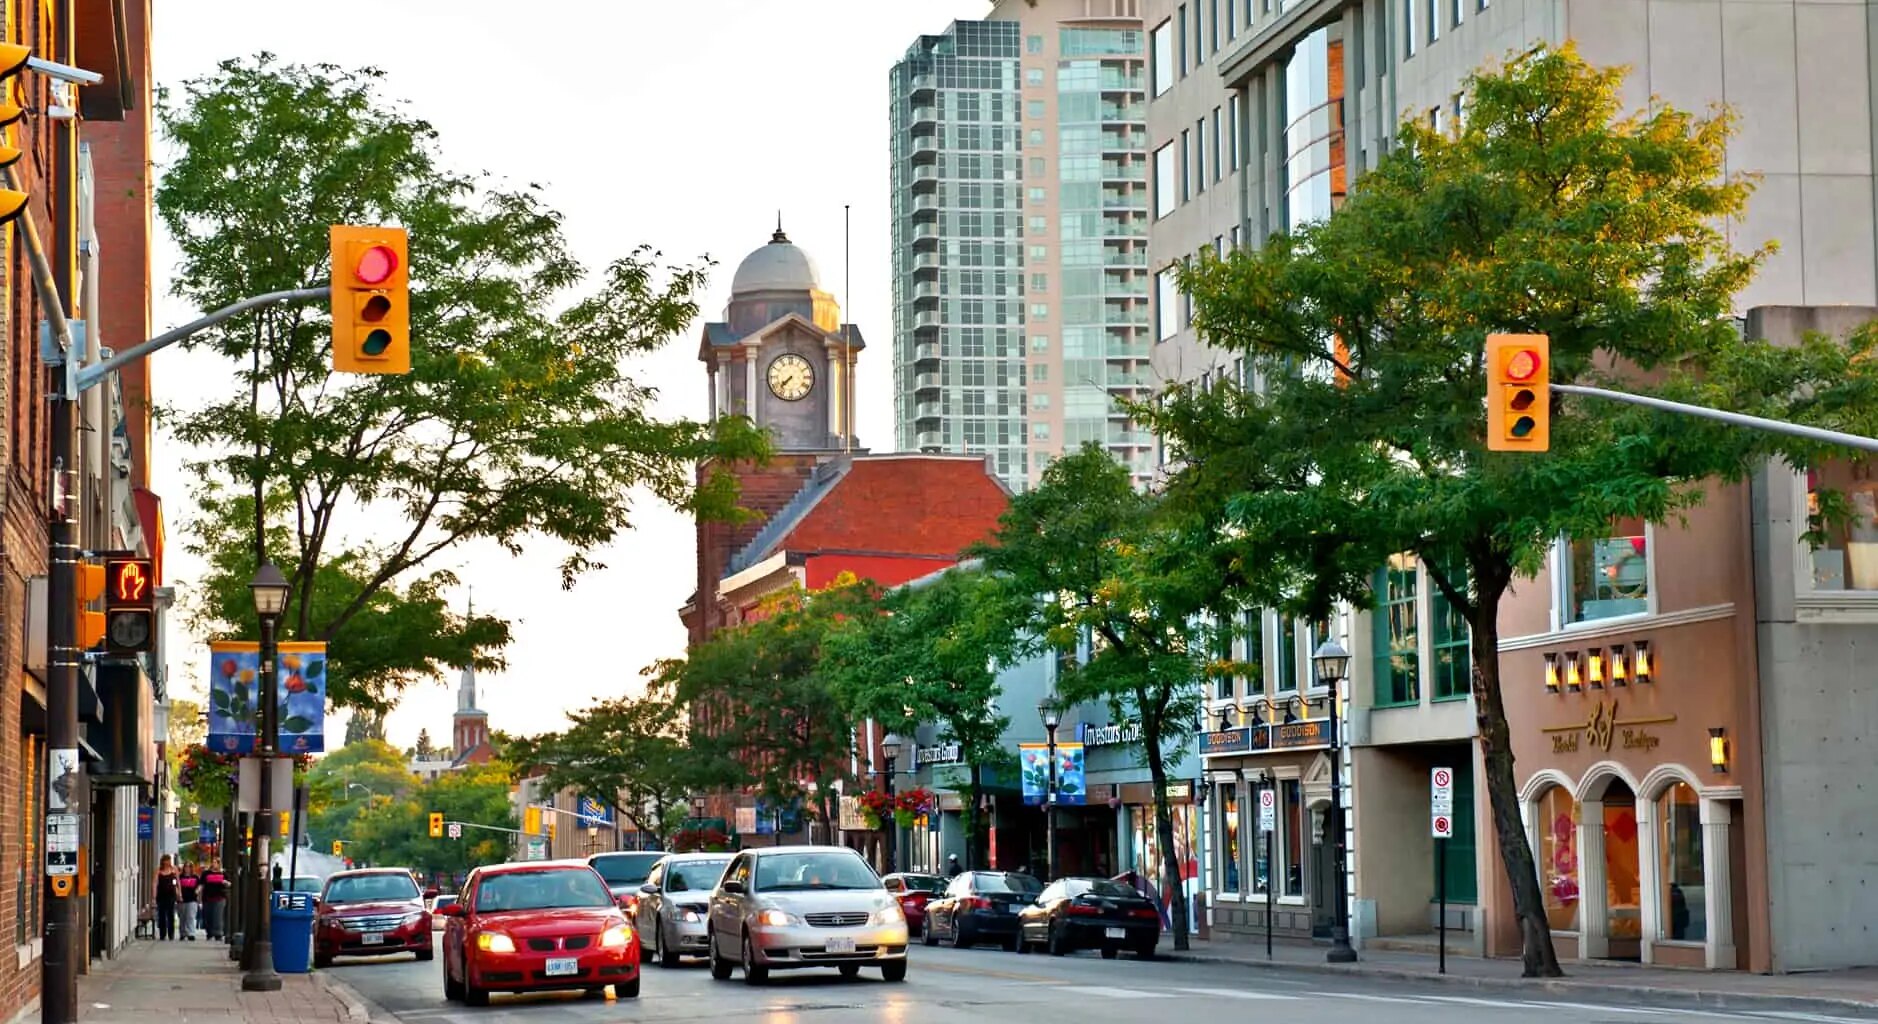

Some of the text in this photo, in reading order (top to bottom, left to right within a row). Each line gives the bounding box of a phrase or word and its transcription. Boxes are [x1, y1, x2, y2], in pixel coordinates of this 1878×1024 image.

[1084, 723, 1121, 746] Investors
[917, 741, 960, 766] Investors Group
